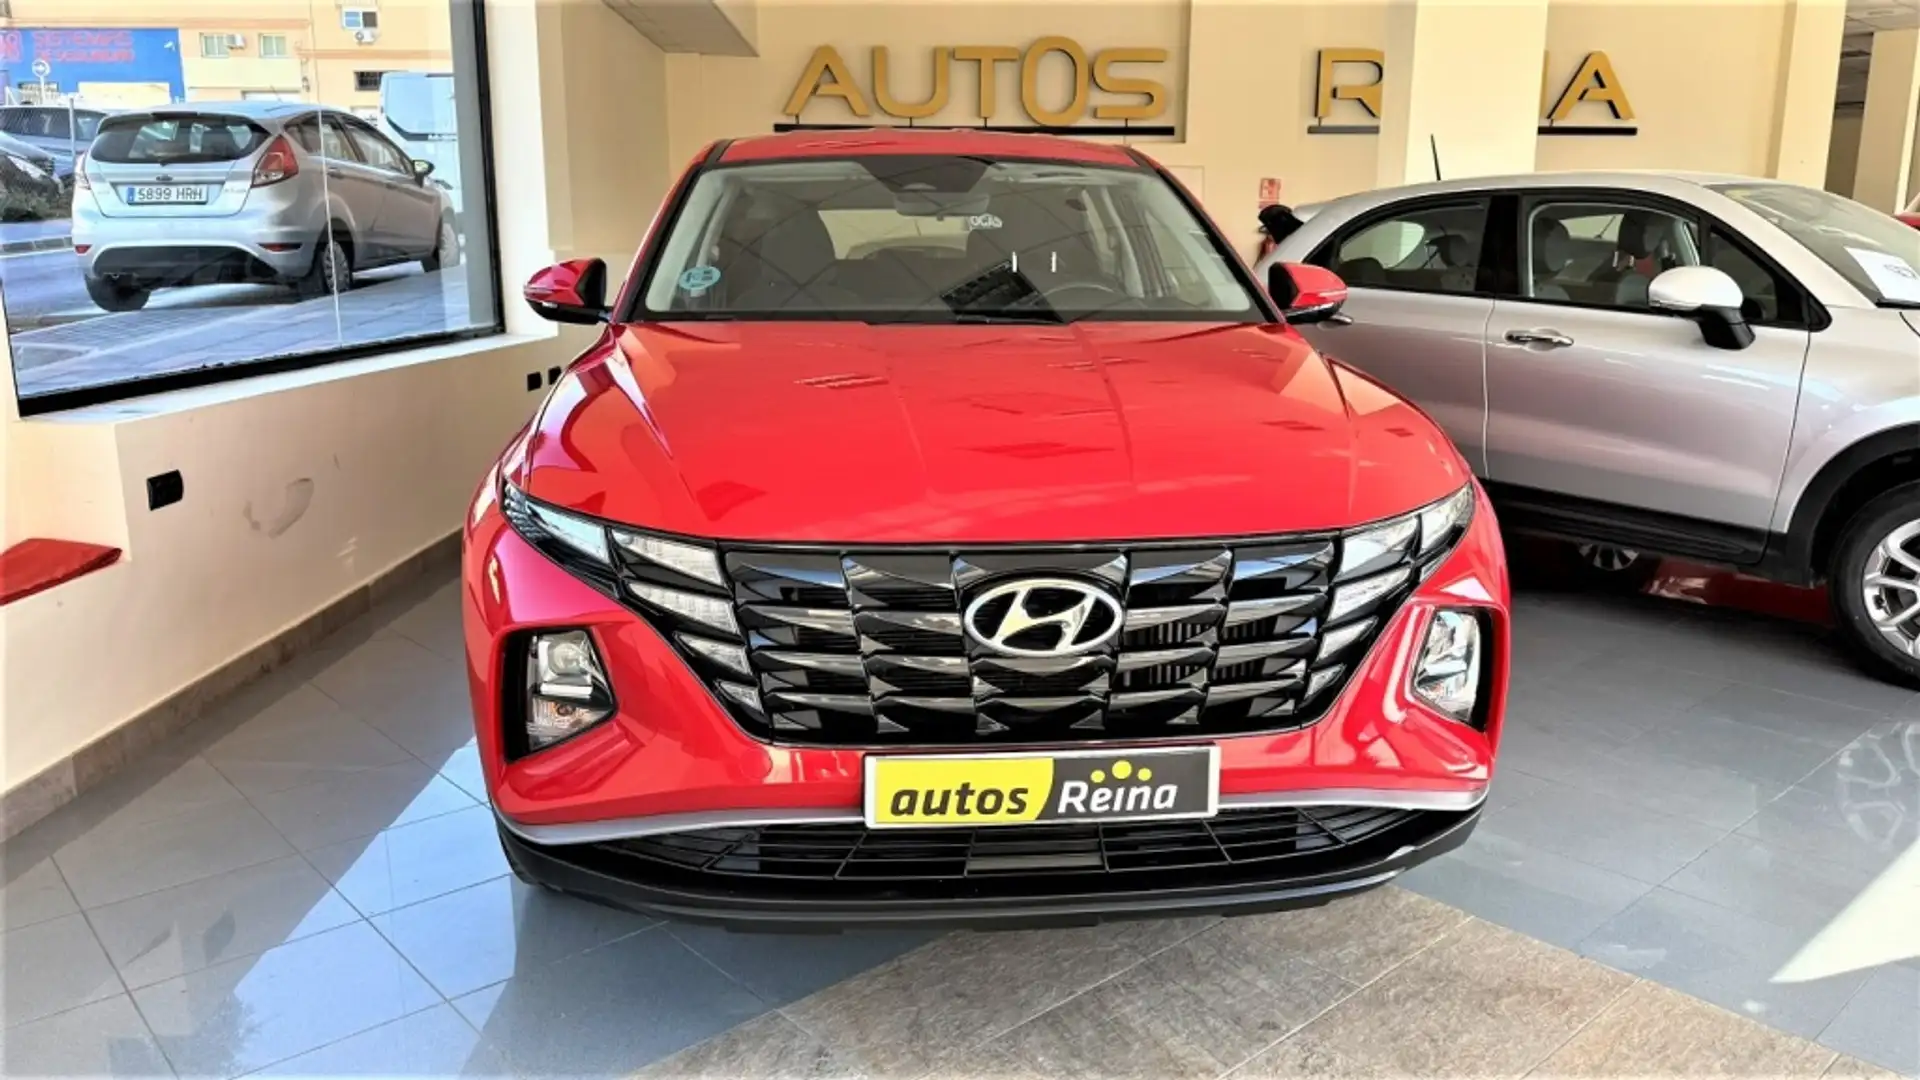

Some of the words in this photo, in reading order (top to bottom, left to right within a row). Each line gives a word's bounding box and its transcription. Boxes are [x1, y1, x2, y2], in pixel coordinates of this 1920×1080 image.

[782, 36, 1168, 126] AUTOS
[138, 187, 172, 200] 5899
[176, 187, 203, 200] HRH
[890, 782, 1028, 816] autos
[1057, 779, 1178, 814] Reina
